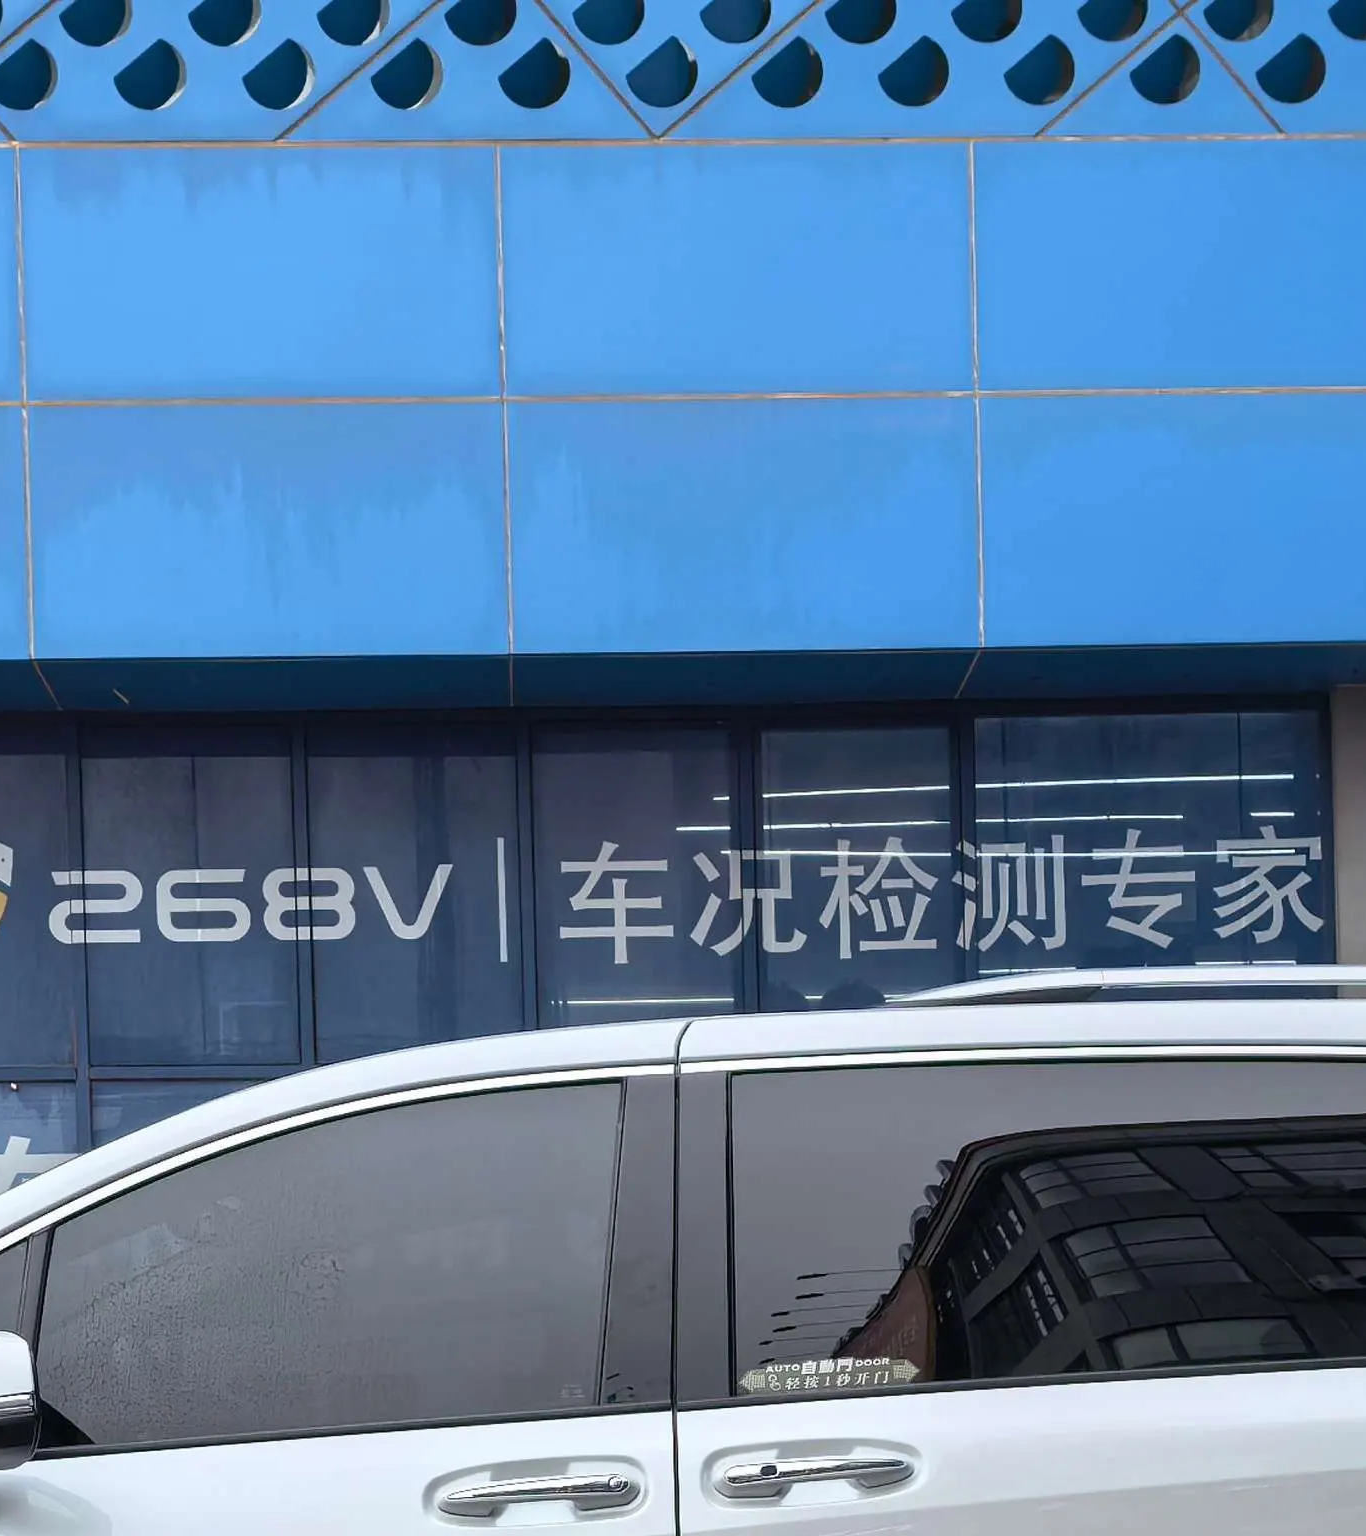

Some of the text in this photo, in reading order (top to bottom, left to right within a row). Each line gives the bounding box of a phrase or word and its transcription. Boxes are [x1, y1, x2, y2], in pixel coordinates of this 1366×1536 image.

[48, 826, 1325, 964] 268V 车况检测专家
[766, 1357, 891, 1375] AUTO 自動門 DOOR
